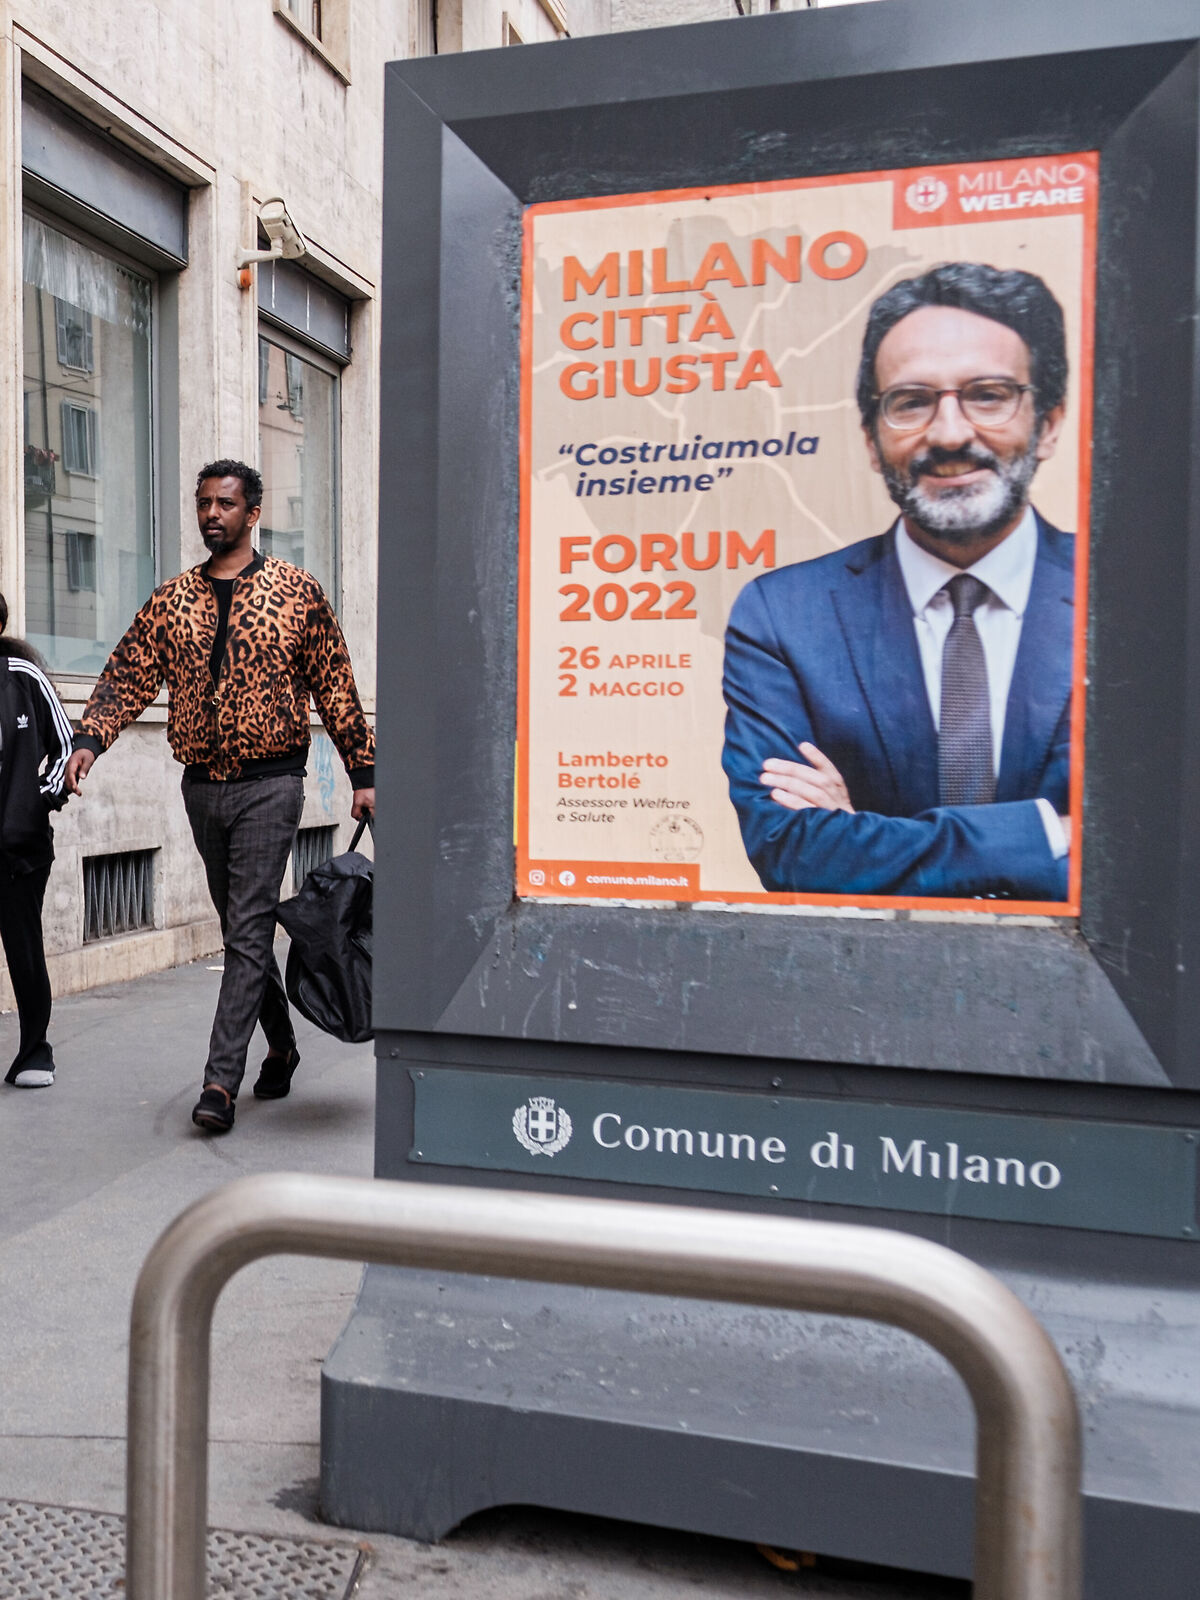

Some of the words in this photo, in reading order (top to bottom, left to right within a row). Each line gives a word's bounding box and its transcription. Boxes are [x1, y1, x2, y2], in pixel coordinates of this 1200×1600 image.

[958, 163, 1086, 193] MILANO
[959, 186, 1085, 213] WELFARE
[562, 230, 868, 302] MILANO
[559, 291, 736, 351] CITTÀ
[559, 349, 783, 401] GIUSTA
[559, 529, 776, 574] FORUM
[558, 580, 697, 622] 2022
[558, 645, 600, 670] 26
[608, 652, 692, 670] APRILE
[557, 673, 578, 697] 2
[589, 681, 684, 698] MAGGIO
[557, 751, 669, 768] Lamberto
[557, 772, 641, 789] Bertolé
[556, 797, 629, 809] Assessore
[632, 797, 691, 809] Welfare
[556, 813, 566, 822] e
[569, 811, 616, 823] Salute
[585, 874, 689, 887] comune.milano.it
[591, 1112, 786, 1165] Comune
[810, 1131, 855, 1171] di
[879, 1136, 1062, 1190] Milano
